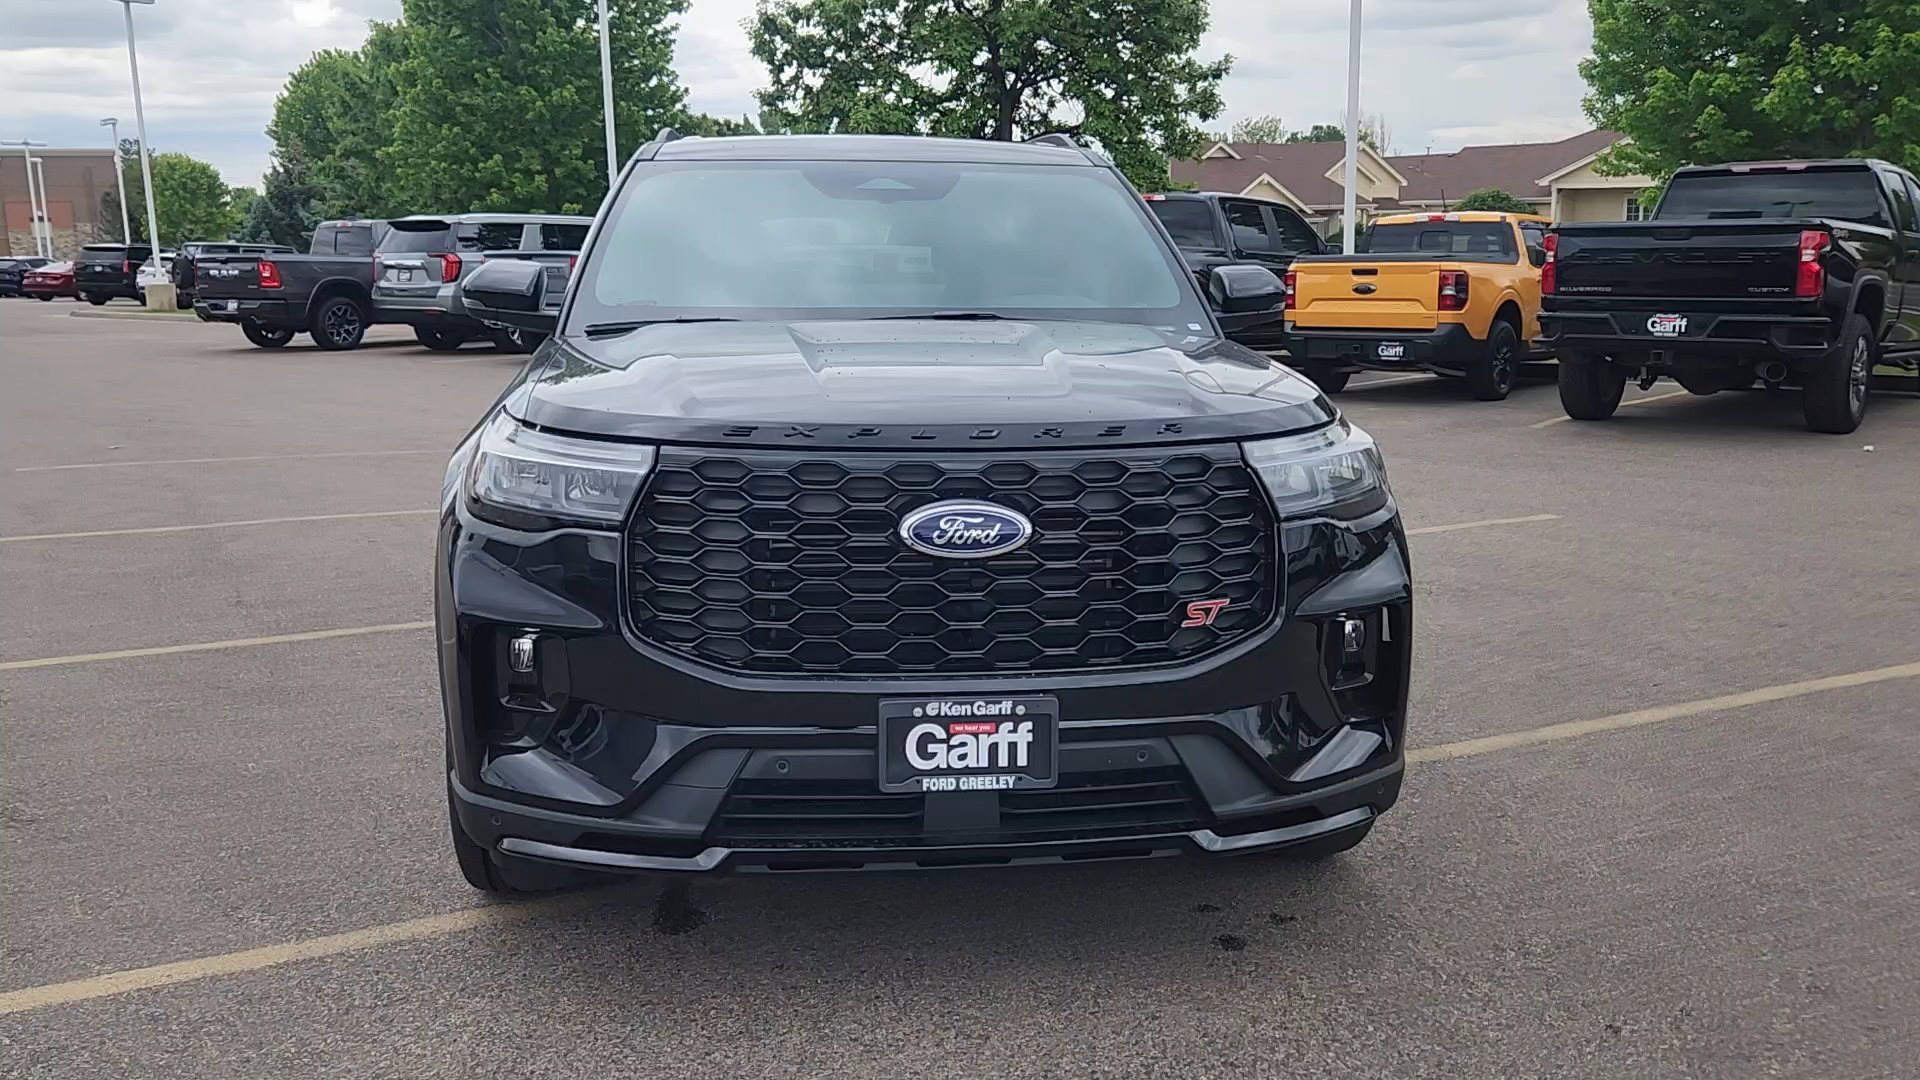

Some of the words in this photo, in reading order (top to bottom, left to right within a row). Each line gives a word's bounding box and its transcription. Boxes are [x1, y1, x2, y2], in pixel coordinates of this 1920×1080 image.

[209, 269, 239, 278] RAM
[1646, 317, 1688, 333] Garff
[722, 422, 1183, 440] EXPLORER
[932, 515, 1002, 545] Ford
[1181, 598, 1231, 628] ST
[940, 702, 972, 716] Ken
[972, 701, 1013, 716] Garff
[905, 721, 1033, 770] Garff
[922, 777, 956, 791] FORD
[959, 775, 1016, 790] GREELEY
